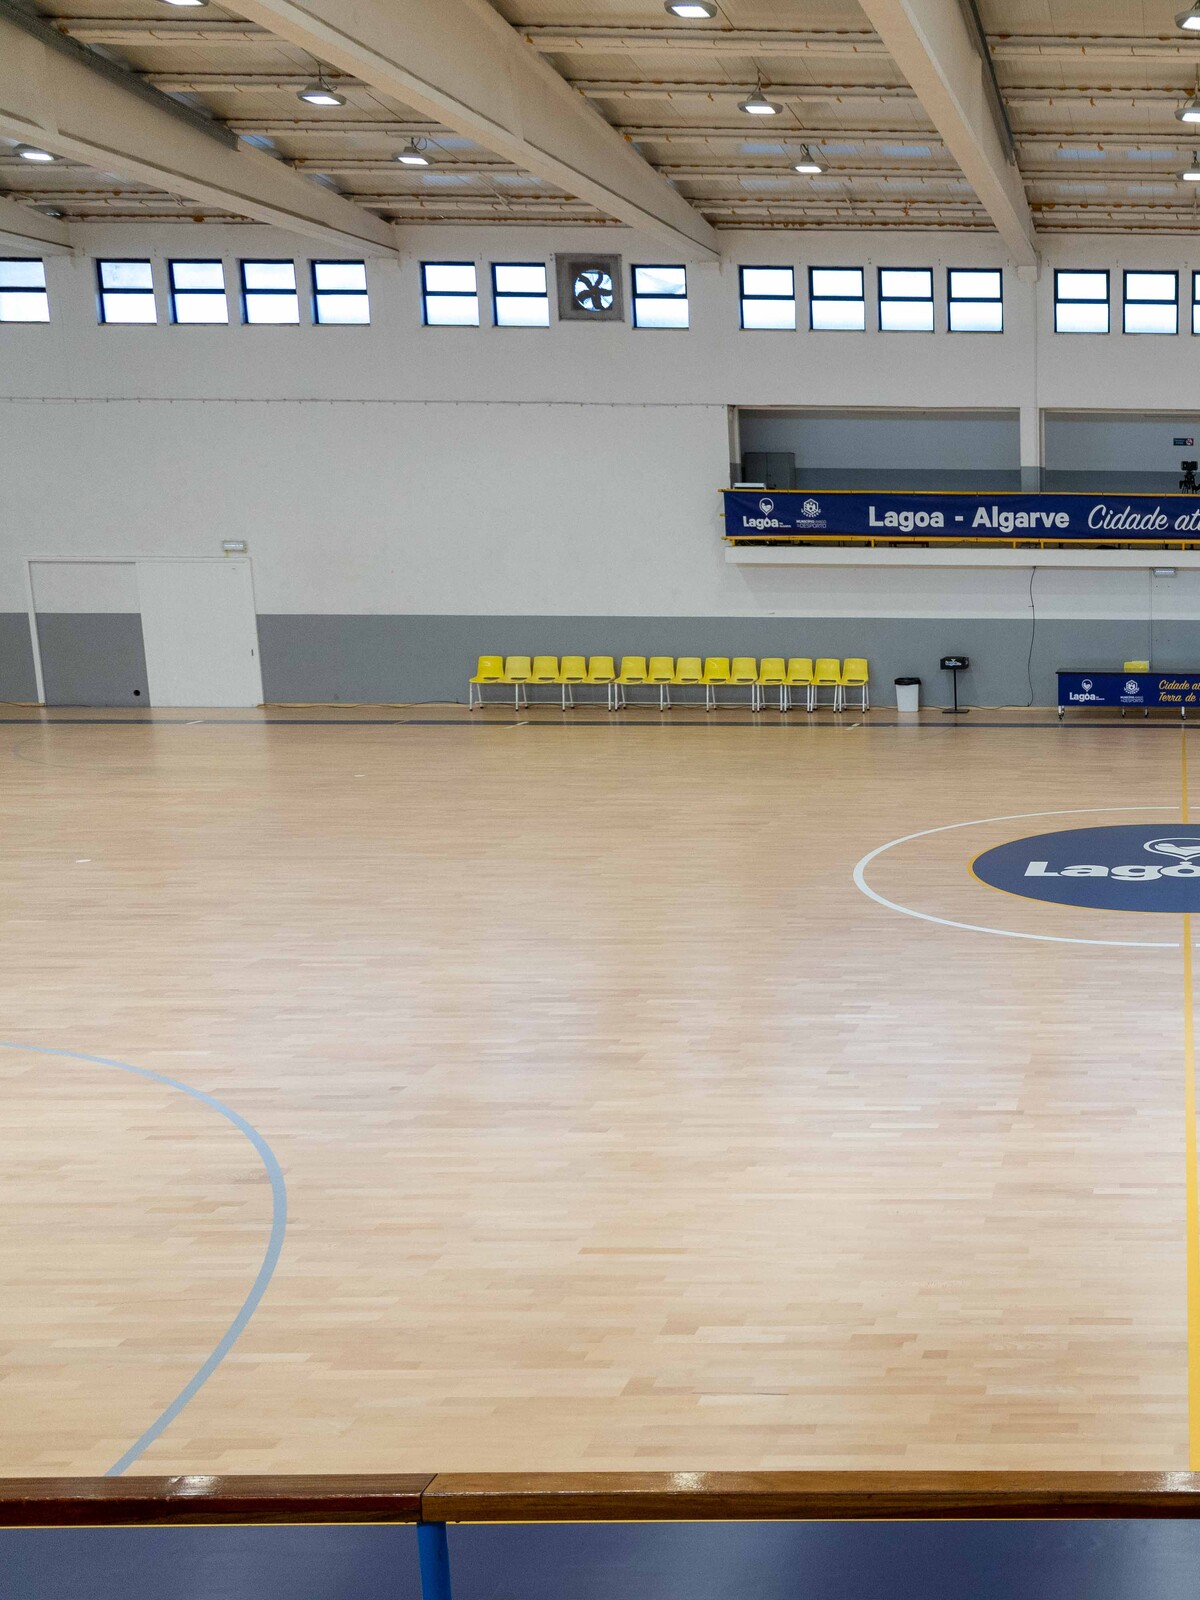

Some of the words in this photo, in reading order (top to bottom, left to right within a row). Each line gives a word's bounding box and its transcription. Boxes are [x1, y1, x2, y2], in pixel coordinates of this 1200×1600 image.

[743, 516, 778, 530] Lagoa
[869, 506, 944, 532] Lagoa
[972, 506, 1070, 532] Algarve
[1088, 504, 1168, 531] Cidade
[1159, 680, 1190, 690] Cidade
[1069, 692, 1096, 702] Lagoa
[1159, 692, 1182, 702] Terra
[1185, 692, 1196, 702] de
